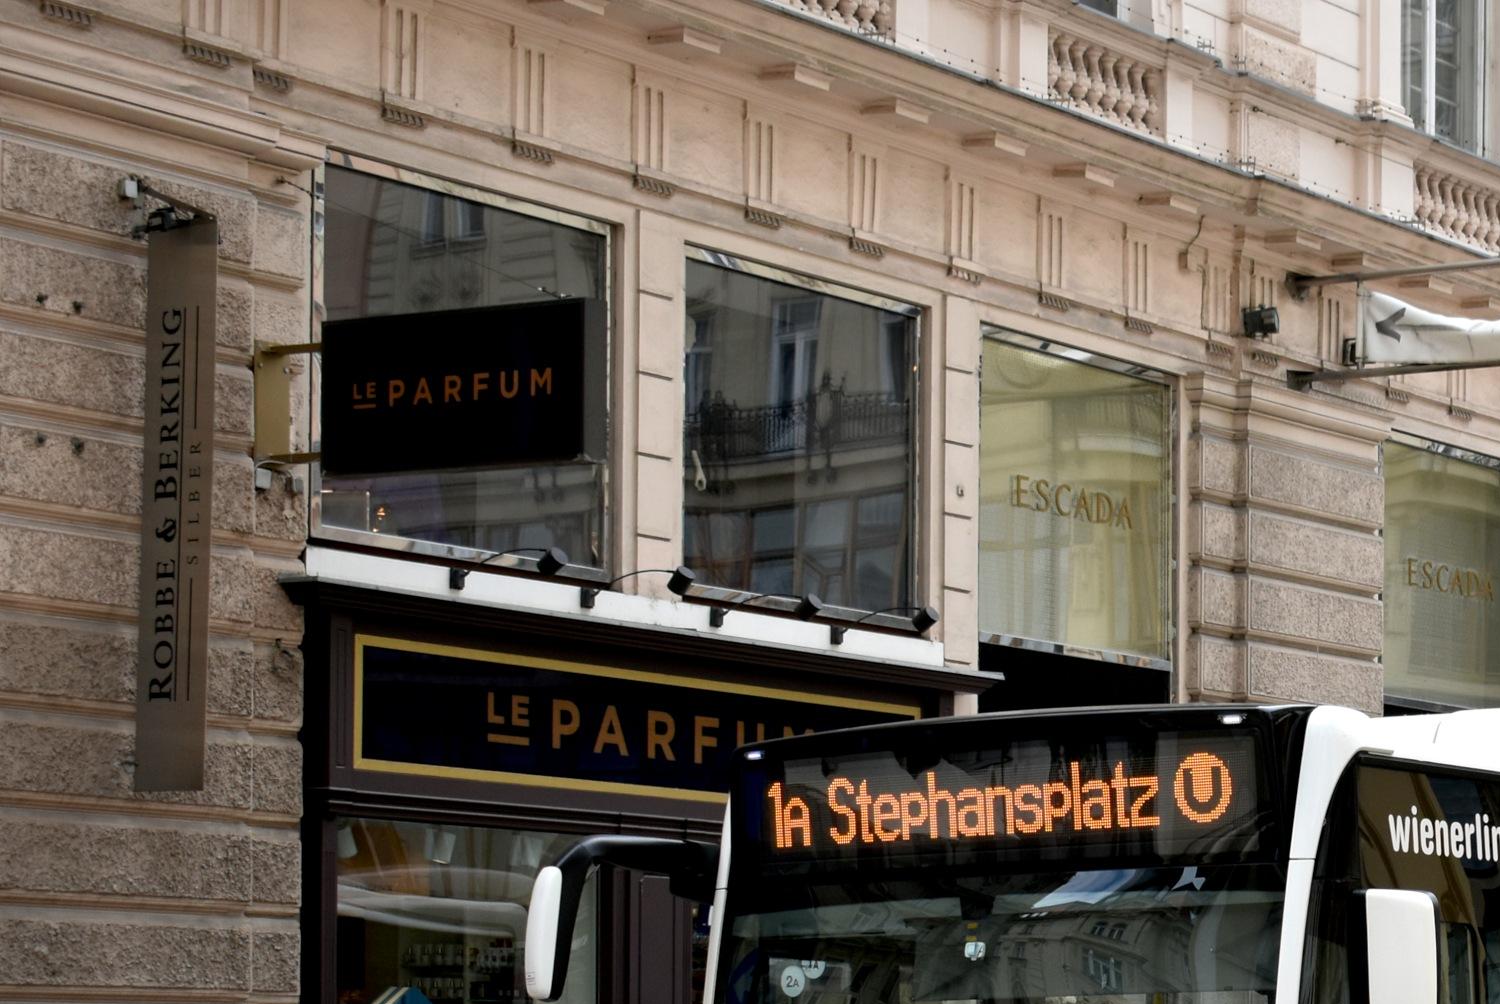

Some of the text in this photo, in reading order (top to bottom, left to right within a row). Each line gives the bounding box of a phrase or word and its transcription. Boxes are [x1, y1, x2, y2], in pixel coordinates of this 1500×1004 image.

[352, 367, 553, 408] LE PARFUM
[149, 307, 183, 702] ROBBE & BERKING
[187, 441, 202, 566] SILBER
[1012, 474, 1133, 530] ESCADA
[1407, 557, 1494, 602] ESCADA
[486, 691, 818, 764] LE PARF
[767, 781, 812, 848] 1A
[828, 760, 1160, 845] Stephansplatz
[786, 975, 800, 988] 2A
